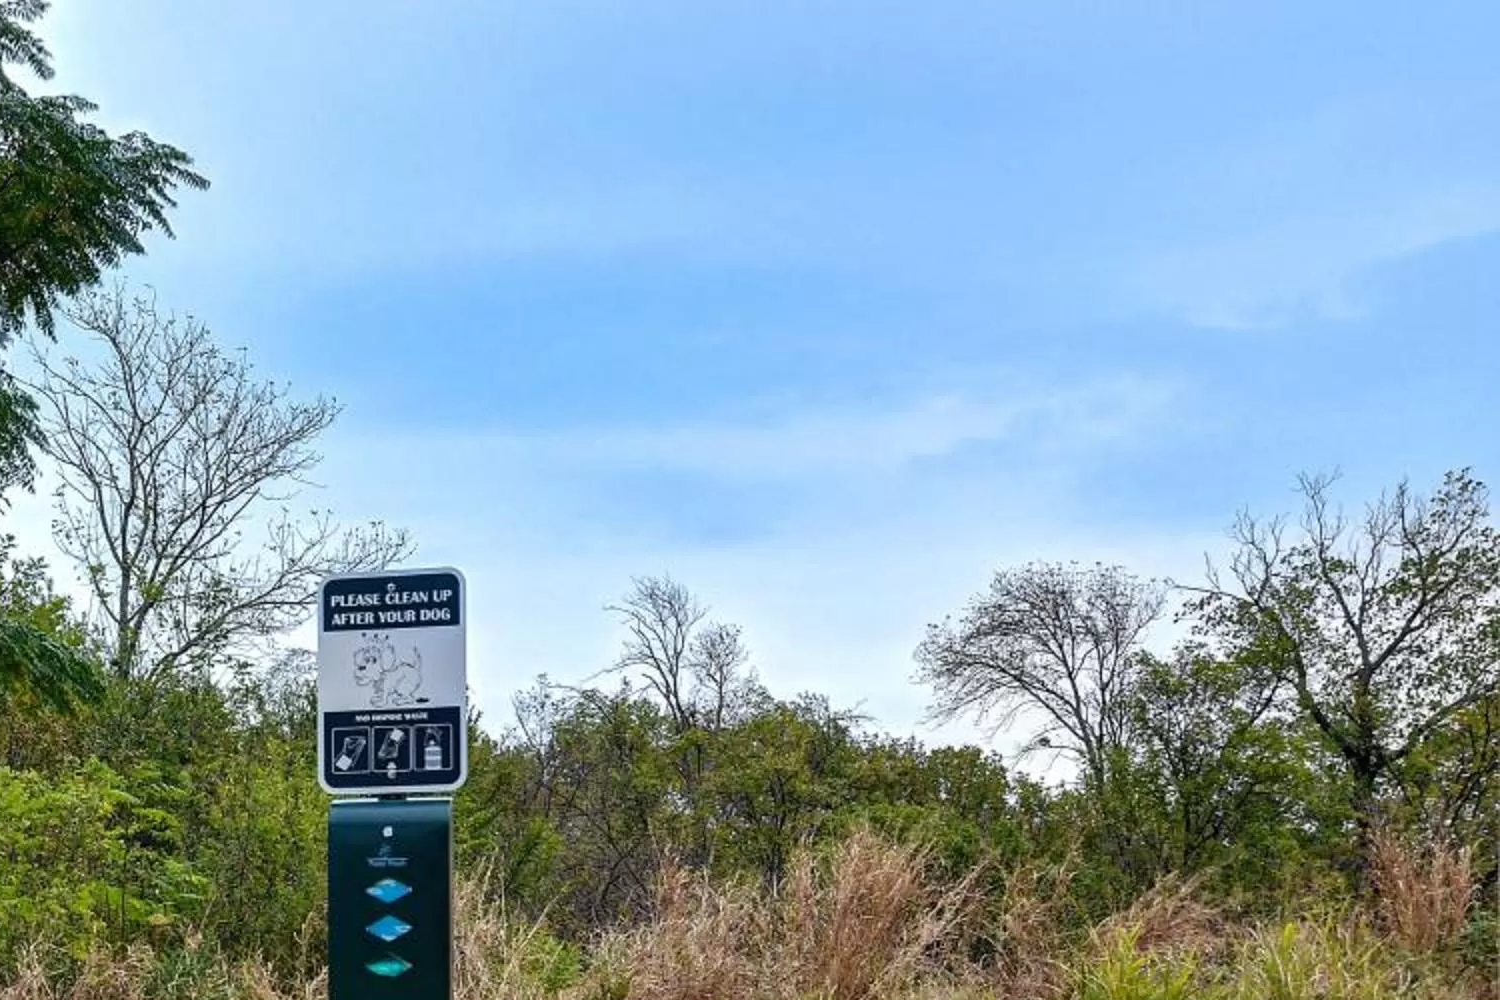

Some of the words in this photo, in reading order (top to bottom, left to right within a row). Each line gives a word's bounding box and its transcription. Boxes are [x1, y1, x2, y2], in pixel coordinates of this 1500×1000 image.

[331, 593, 381, 607] PLEASE
[385, 590, 429, 605] CLEAN
[433, 589, 452, 603] UP
[331, 611, 375, 626] AFTER
[378, 609, 416, 623] YOUR
[420, 608, 451, 621] DOG
